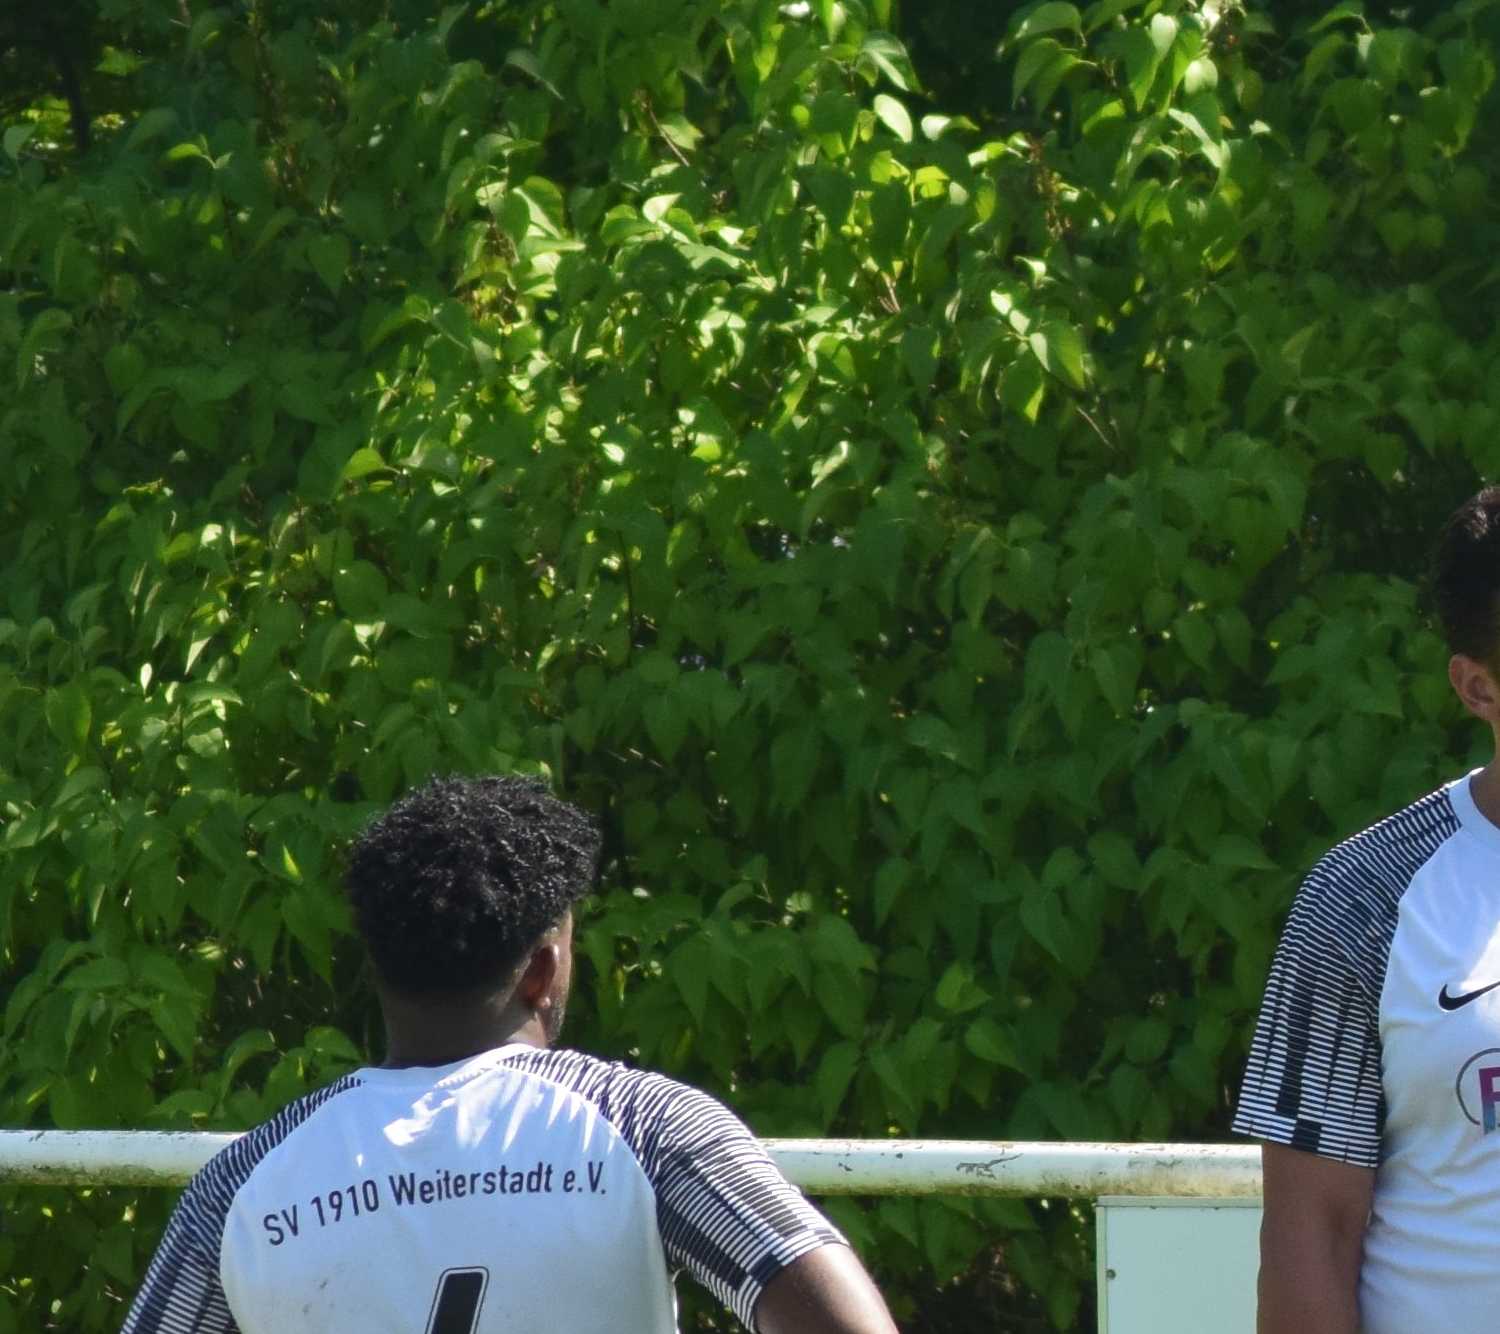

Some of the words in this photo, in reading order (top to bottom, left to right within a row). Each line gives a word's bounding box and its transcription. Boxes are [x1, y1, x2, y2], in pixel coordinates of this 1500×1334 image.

[262, 1203, 300, 1247] SV
[309, 1178, 381, 1228] 1910
[388, 1161, 554, 1206] Weiterstadt
